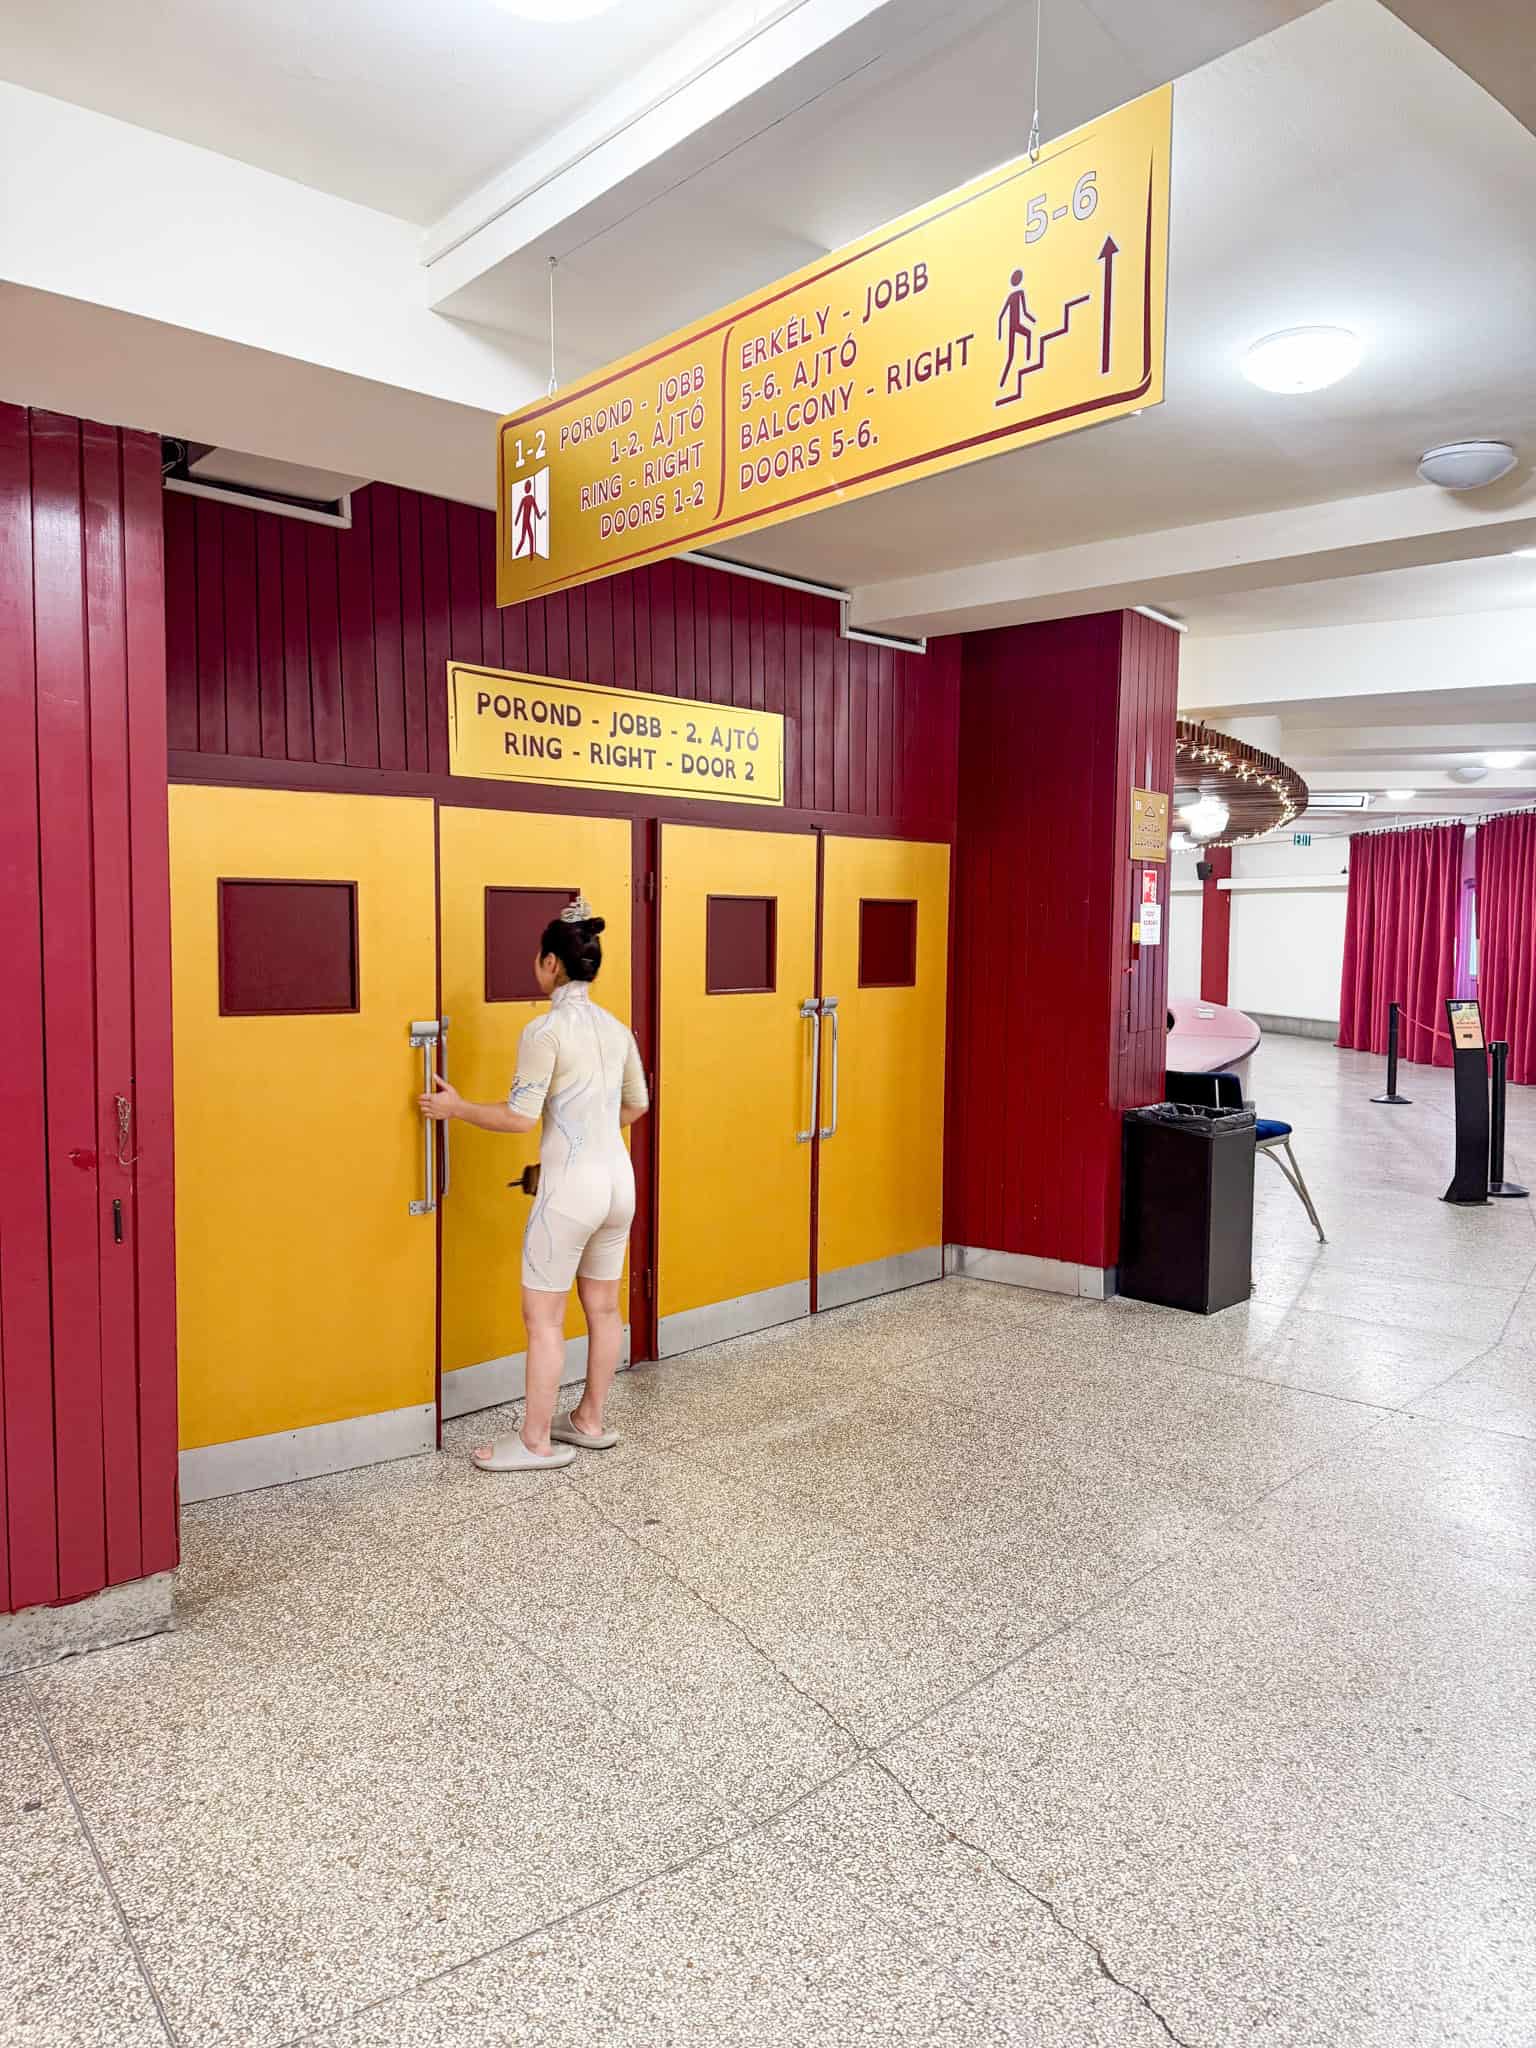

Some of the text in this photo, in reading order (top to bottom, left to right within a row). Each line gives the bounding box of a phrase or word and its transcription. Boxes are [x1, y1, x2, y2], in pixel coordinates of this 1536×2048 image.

[1025, 171, 1098, 244] 5-6
[742, 305, 830, 370] ERKÉLY
[862, 262, 929, 323] JOBB
[741, 332, 857, 410] 5-6. AJTÓ
[741, 382, 854, 450] BALCONY
[887, 334, 974, 394] RIGHT
[560, 398, 634, 449] POROND
[656, 365, 705, 414] JOBB
[611, 398, 705, 463] 1-2. AJTÓ
[515, 430, 546, 468] 1-2
[581, 475, 622, 511] RING
[644, 442, 704, 486] RIGHT
[740, 419, 878, 490] DOORS 5-6.
[600, 481, 704, 538] DOORS 1-2
[477, 692, 582, 727] POROND
[609, 711, 662, 738] JOBB
[686, 722, 702, 744] 2.
[710, 727, 759, 752] AJTÓ
[504, 732, 562, 760] RING
[590, 742, 657, 770] RIGHT
[681, 754, 737, 780] DOOR
[745, 761, 754, 781] 2
